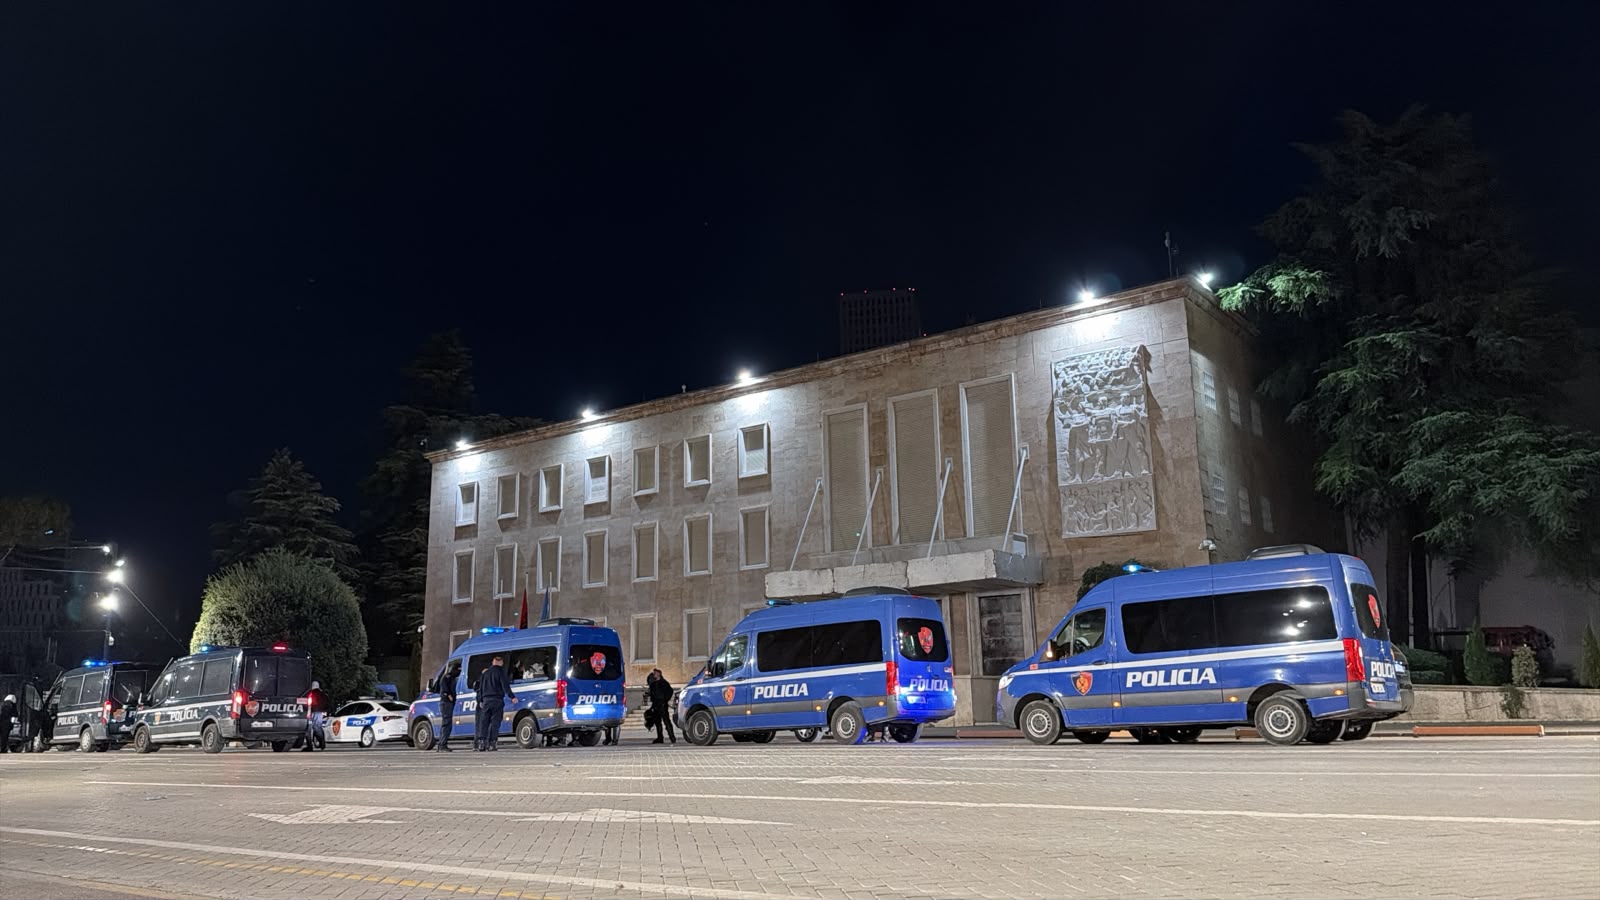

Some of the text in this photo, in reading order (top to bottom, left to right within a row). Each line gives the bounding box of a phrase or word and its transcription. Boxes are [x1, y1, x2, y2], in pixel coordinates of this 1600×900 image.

[1370, 661, 1396, 679] POLICIA
[1125, 667, 1217, 688] POLICIA
[753, 682, 809, 700] POLICIA
[909, 678, 949, 692] POLICIA
[575, 694, 617, 705] POLICIA
[261, 703, 304, 713] POLICIA
[57, 716, 79, 726] POLICIA
[170, 709, 199, 721] POLICIA
